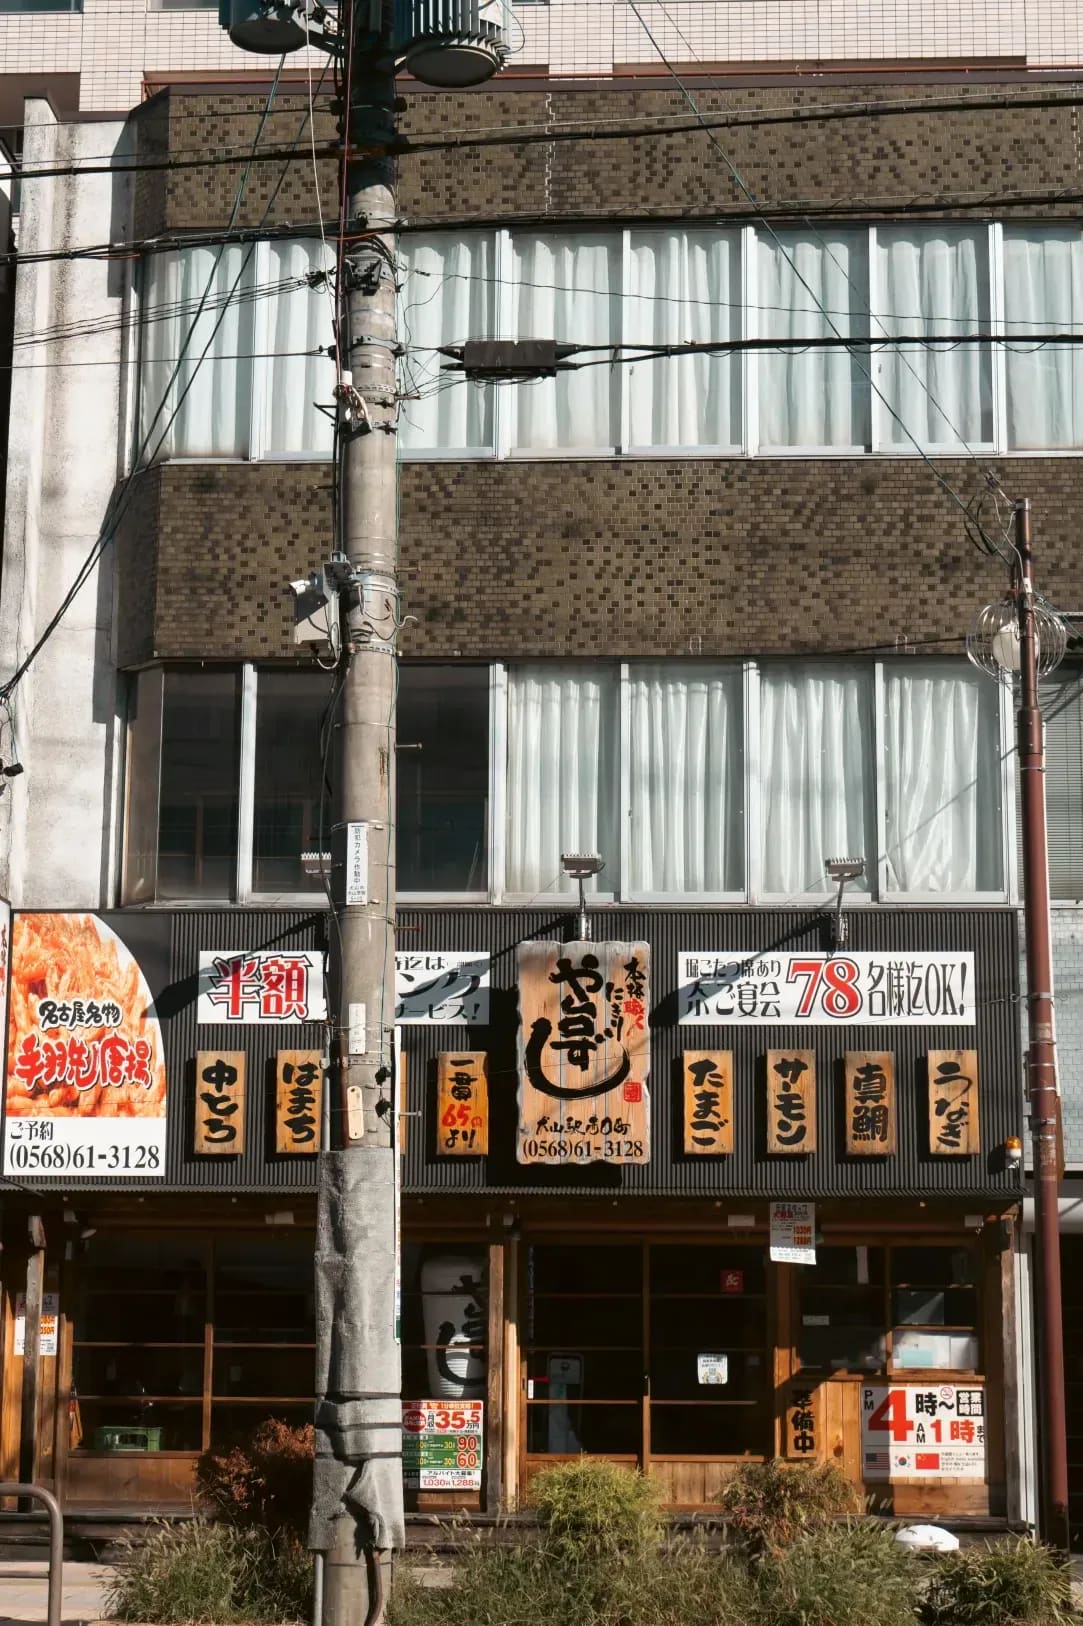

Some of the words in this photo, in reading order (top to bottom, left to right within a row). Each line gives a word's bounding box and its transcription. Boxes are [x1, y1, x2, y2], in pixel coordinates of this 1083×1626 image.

[38, 1000, 121, 1029] 名古屋名物
[207, 954, 312, 1019] 半額
[15, 1033, 152, 1090] 手羽先唐揚
[10, 1120, 55, 1141] ご予約
[199, 1058, 238, 1143] 中とろ
[281, 1061, 319, 1144] はまち
[687, 1058, 730, 1146] たまご
[772, 1057, 809, 1146] サーモン
[851, 1062, 889, 1142] 真鯛
[932, 1060, 973, 1147] うなぎ
[9, 1142, 160, 1170] (0568)61-3128
[522, 1139, 644, 1159] (0568)61-3128
[957, 1391, 983, 1415] 営業時間
